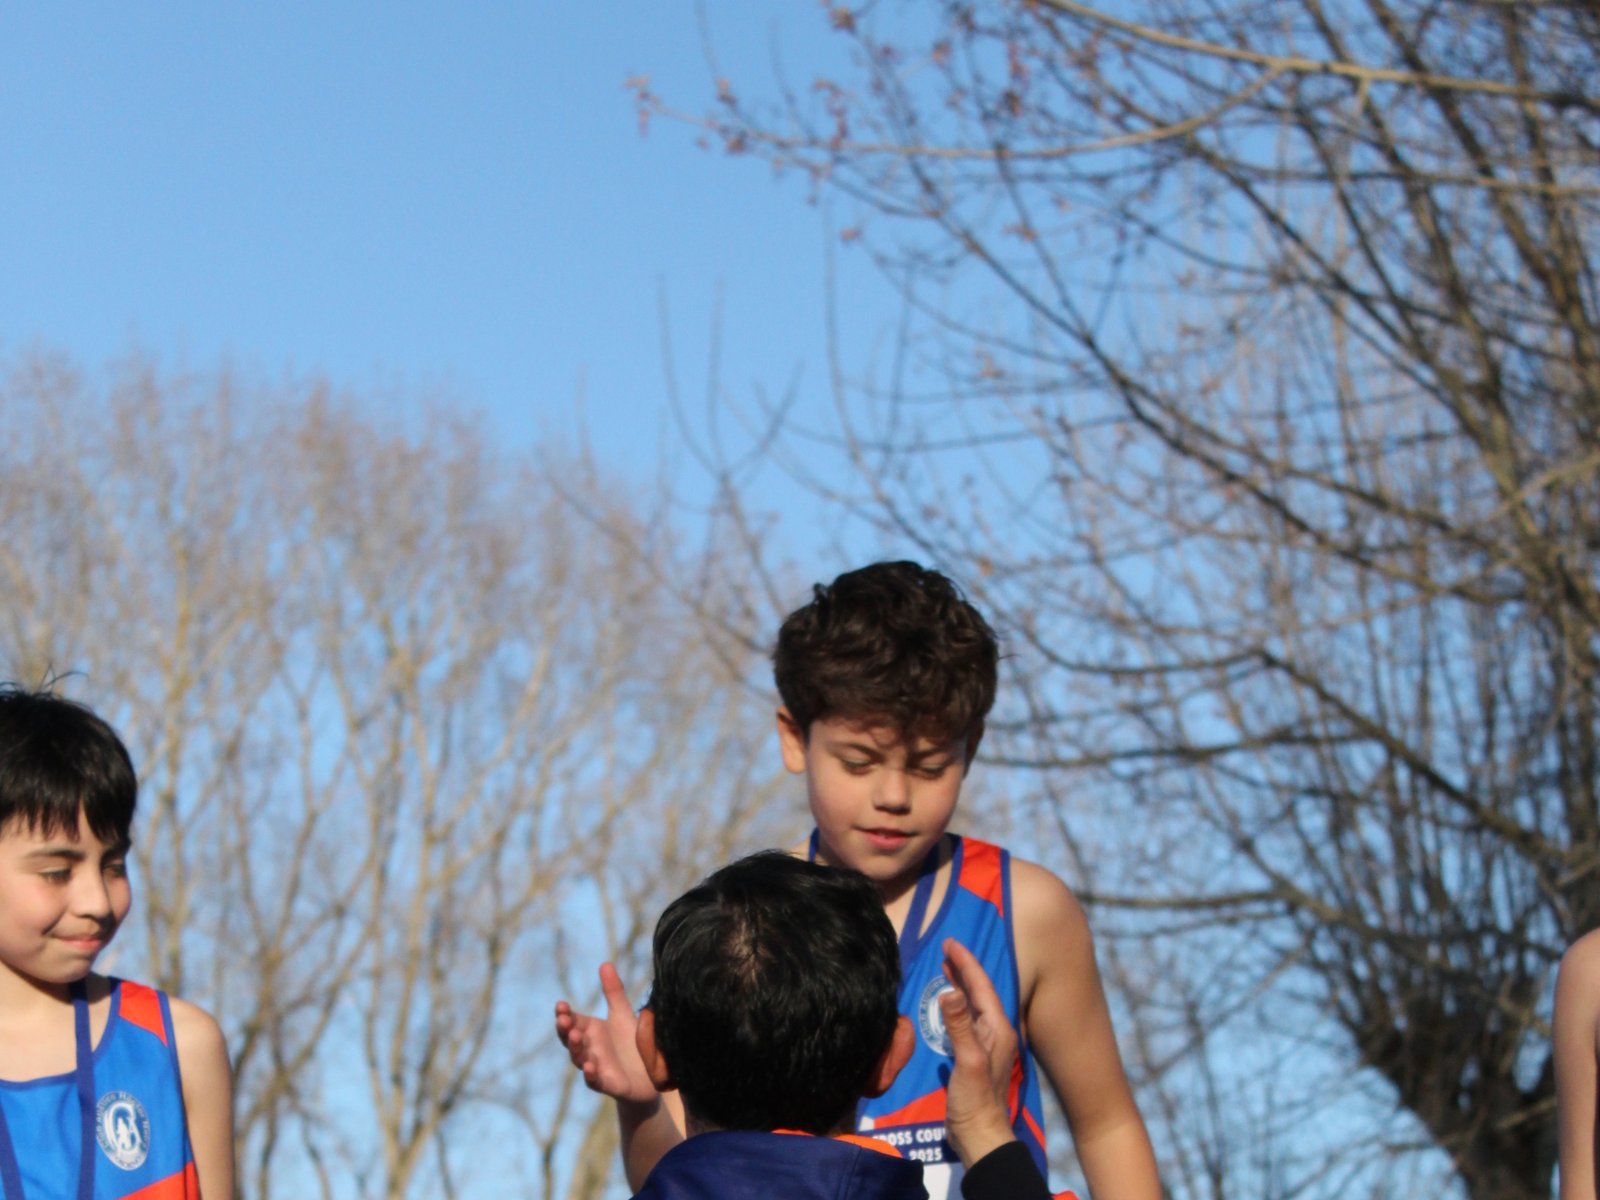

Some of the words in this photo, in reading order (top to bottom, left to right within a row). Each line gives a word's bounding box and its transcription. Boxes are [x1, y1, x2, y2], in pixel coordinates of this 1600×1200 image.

[872, 1130, 913, 1147] OSS
[916, 1126, 946, 1143] COU
[908, 1147, 943, 1162] 2025
